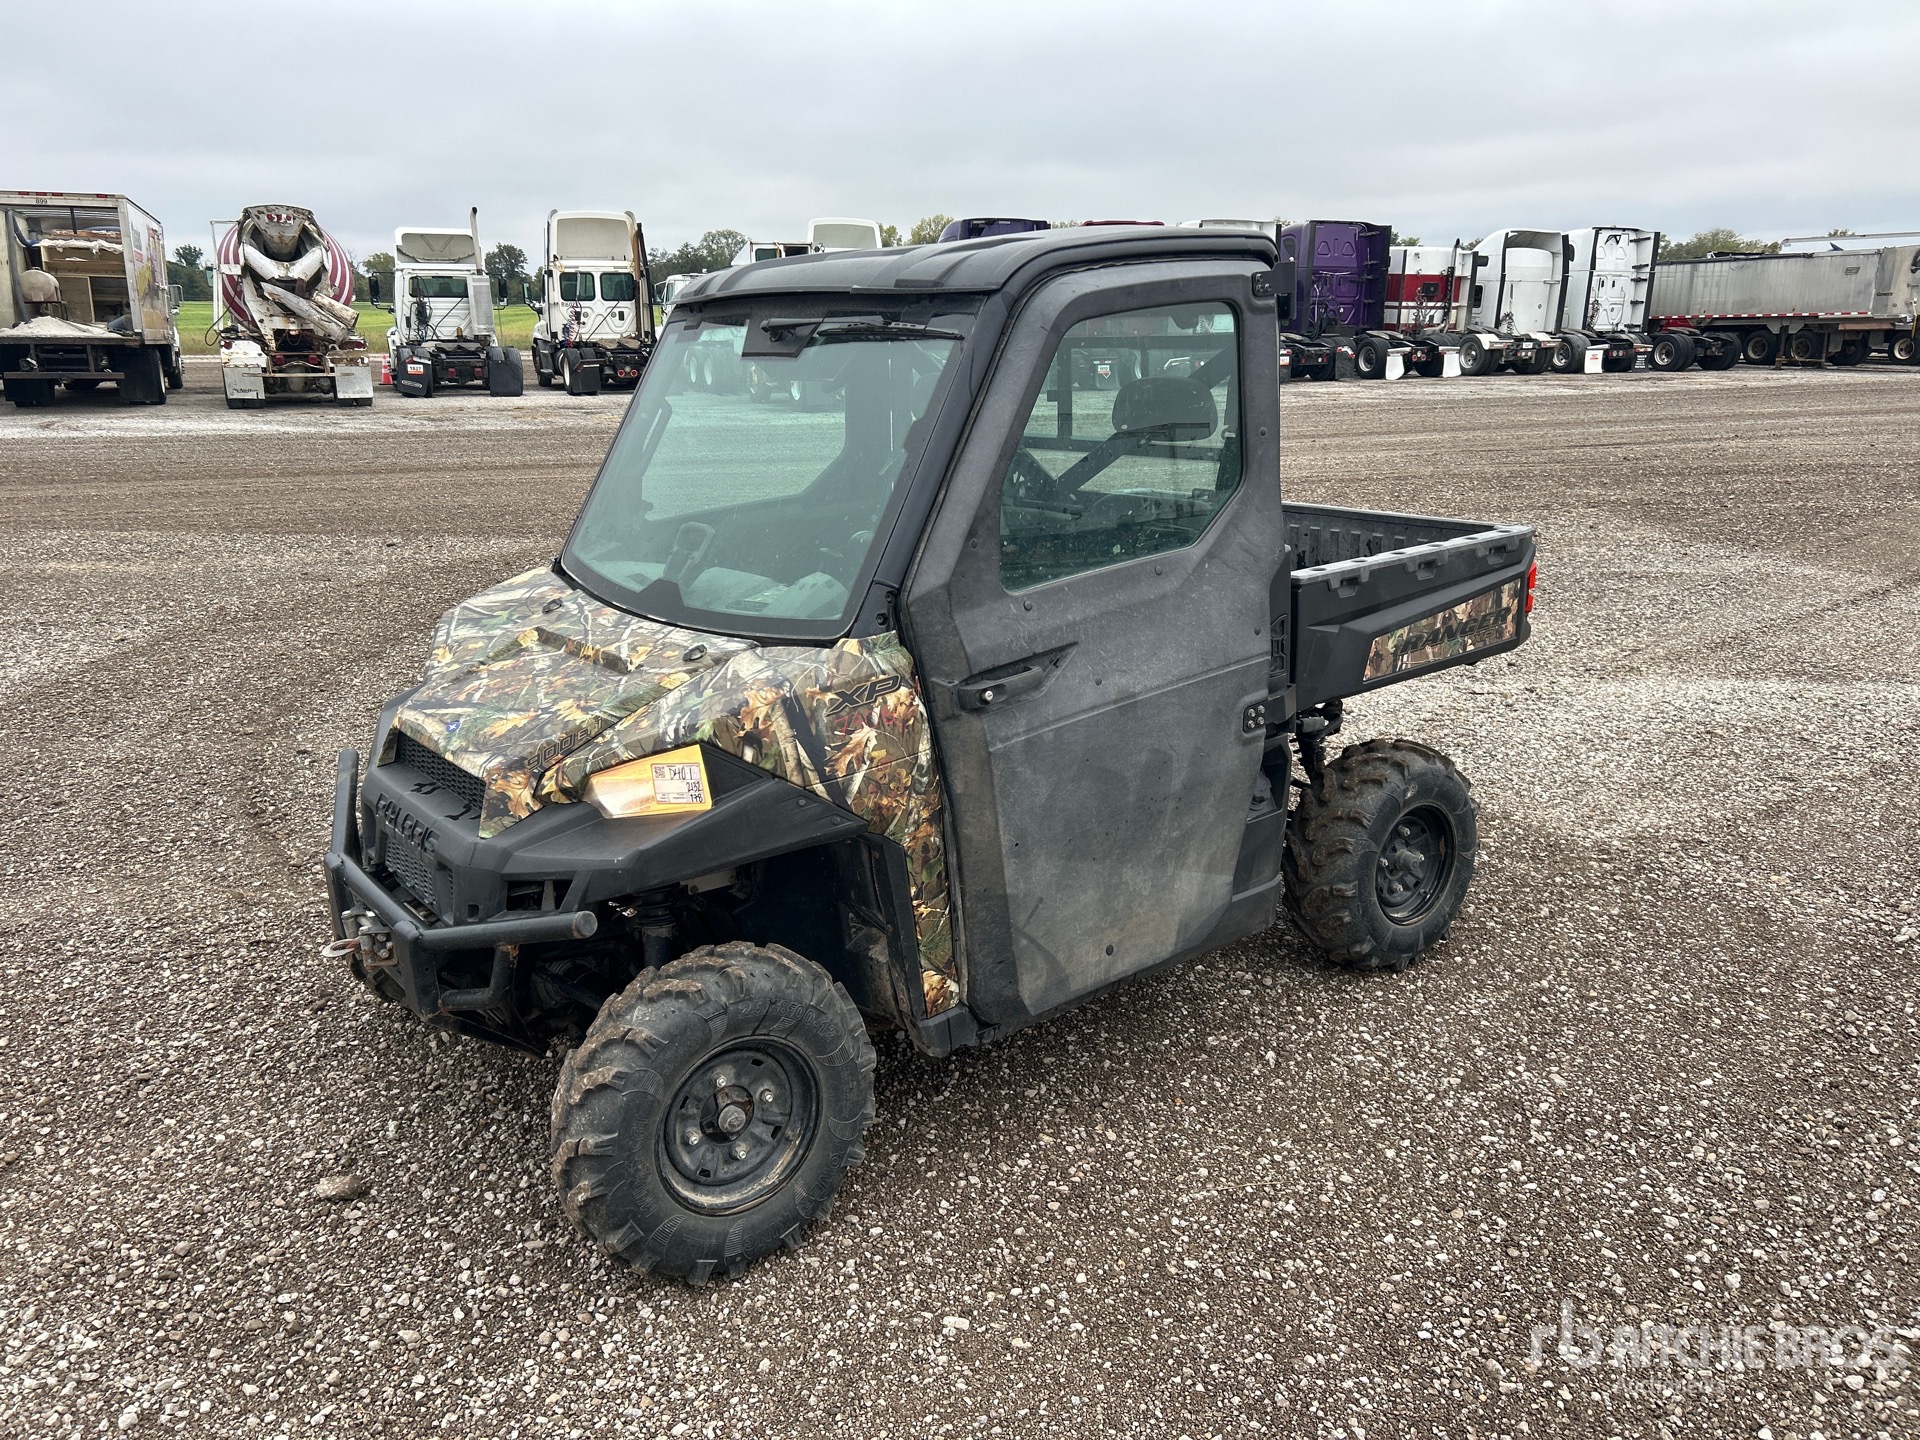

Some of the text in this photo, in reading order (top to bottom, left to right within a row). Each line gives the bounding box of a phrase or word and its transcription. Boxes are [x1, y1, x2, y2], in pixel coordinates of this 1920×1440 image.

[1398, 606, 1513, 656] RANGER
[1471, 627, 1496, 646] XP
[825, 674, 901, 718] XP
[375, 792, 441, 853] POLARIS
[799, 1139, 848, 1214] POWER
